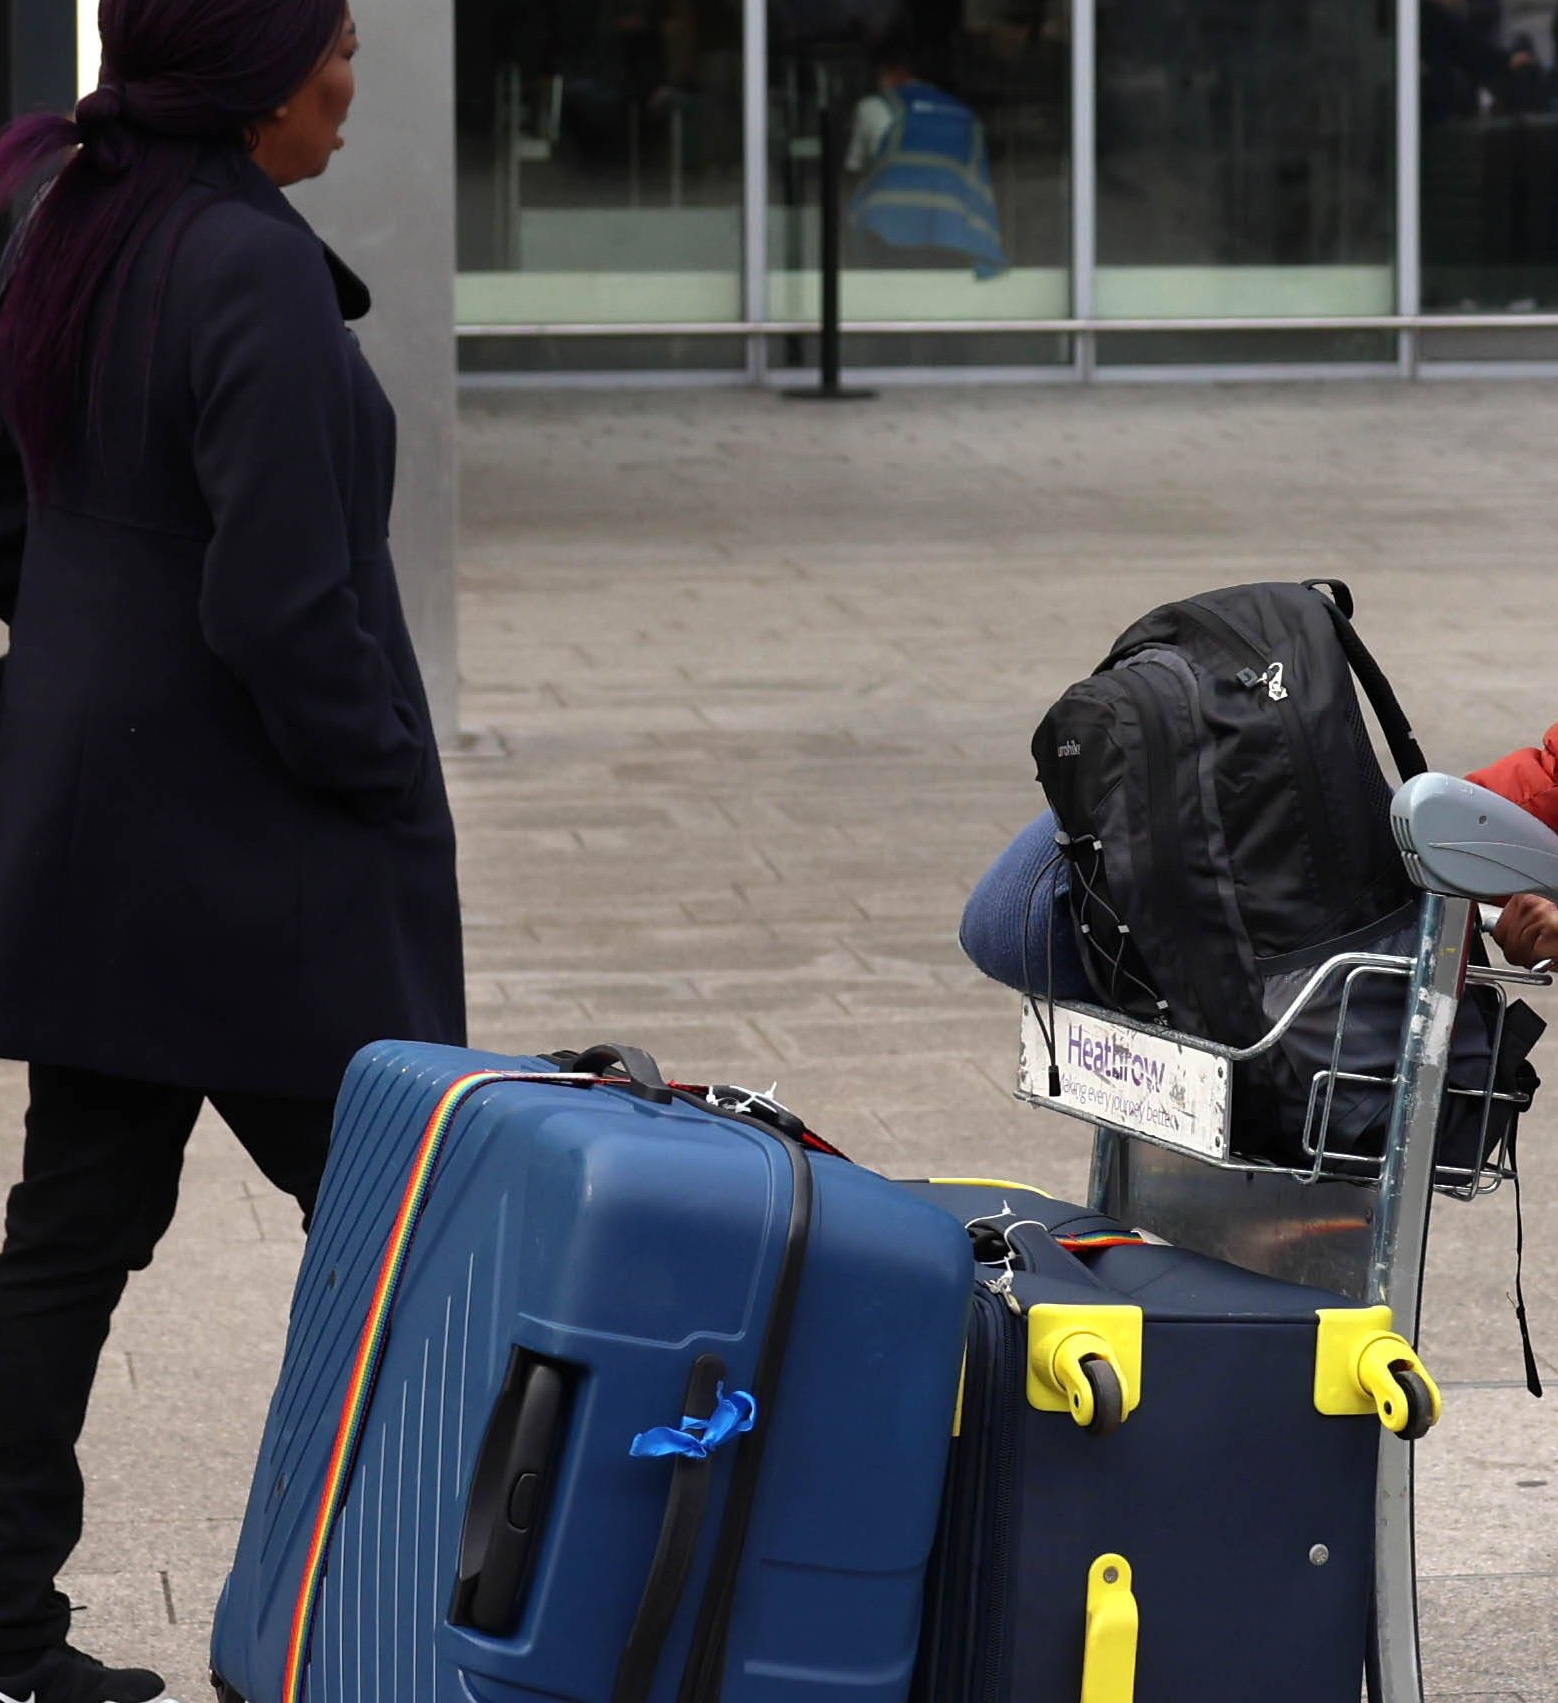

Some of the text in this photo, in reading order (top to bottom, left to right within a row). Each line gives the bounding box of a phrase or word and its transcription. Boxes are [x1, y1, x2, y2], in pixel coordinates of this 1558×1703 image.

[1067, 1023, 1166, 1094] Heathrow
[1088, 1087, 1111, 1114] every
[1110, 1094, 1145, 1125] journey
